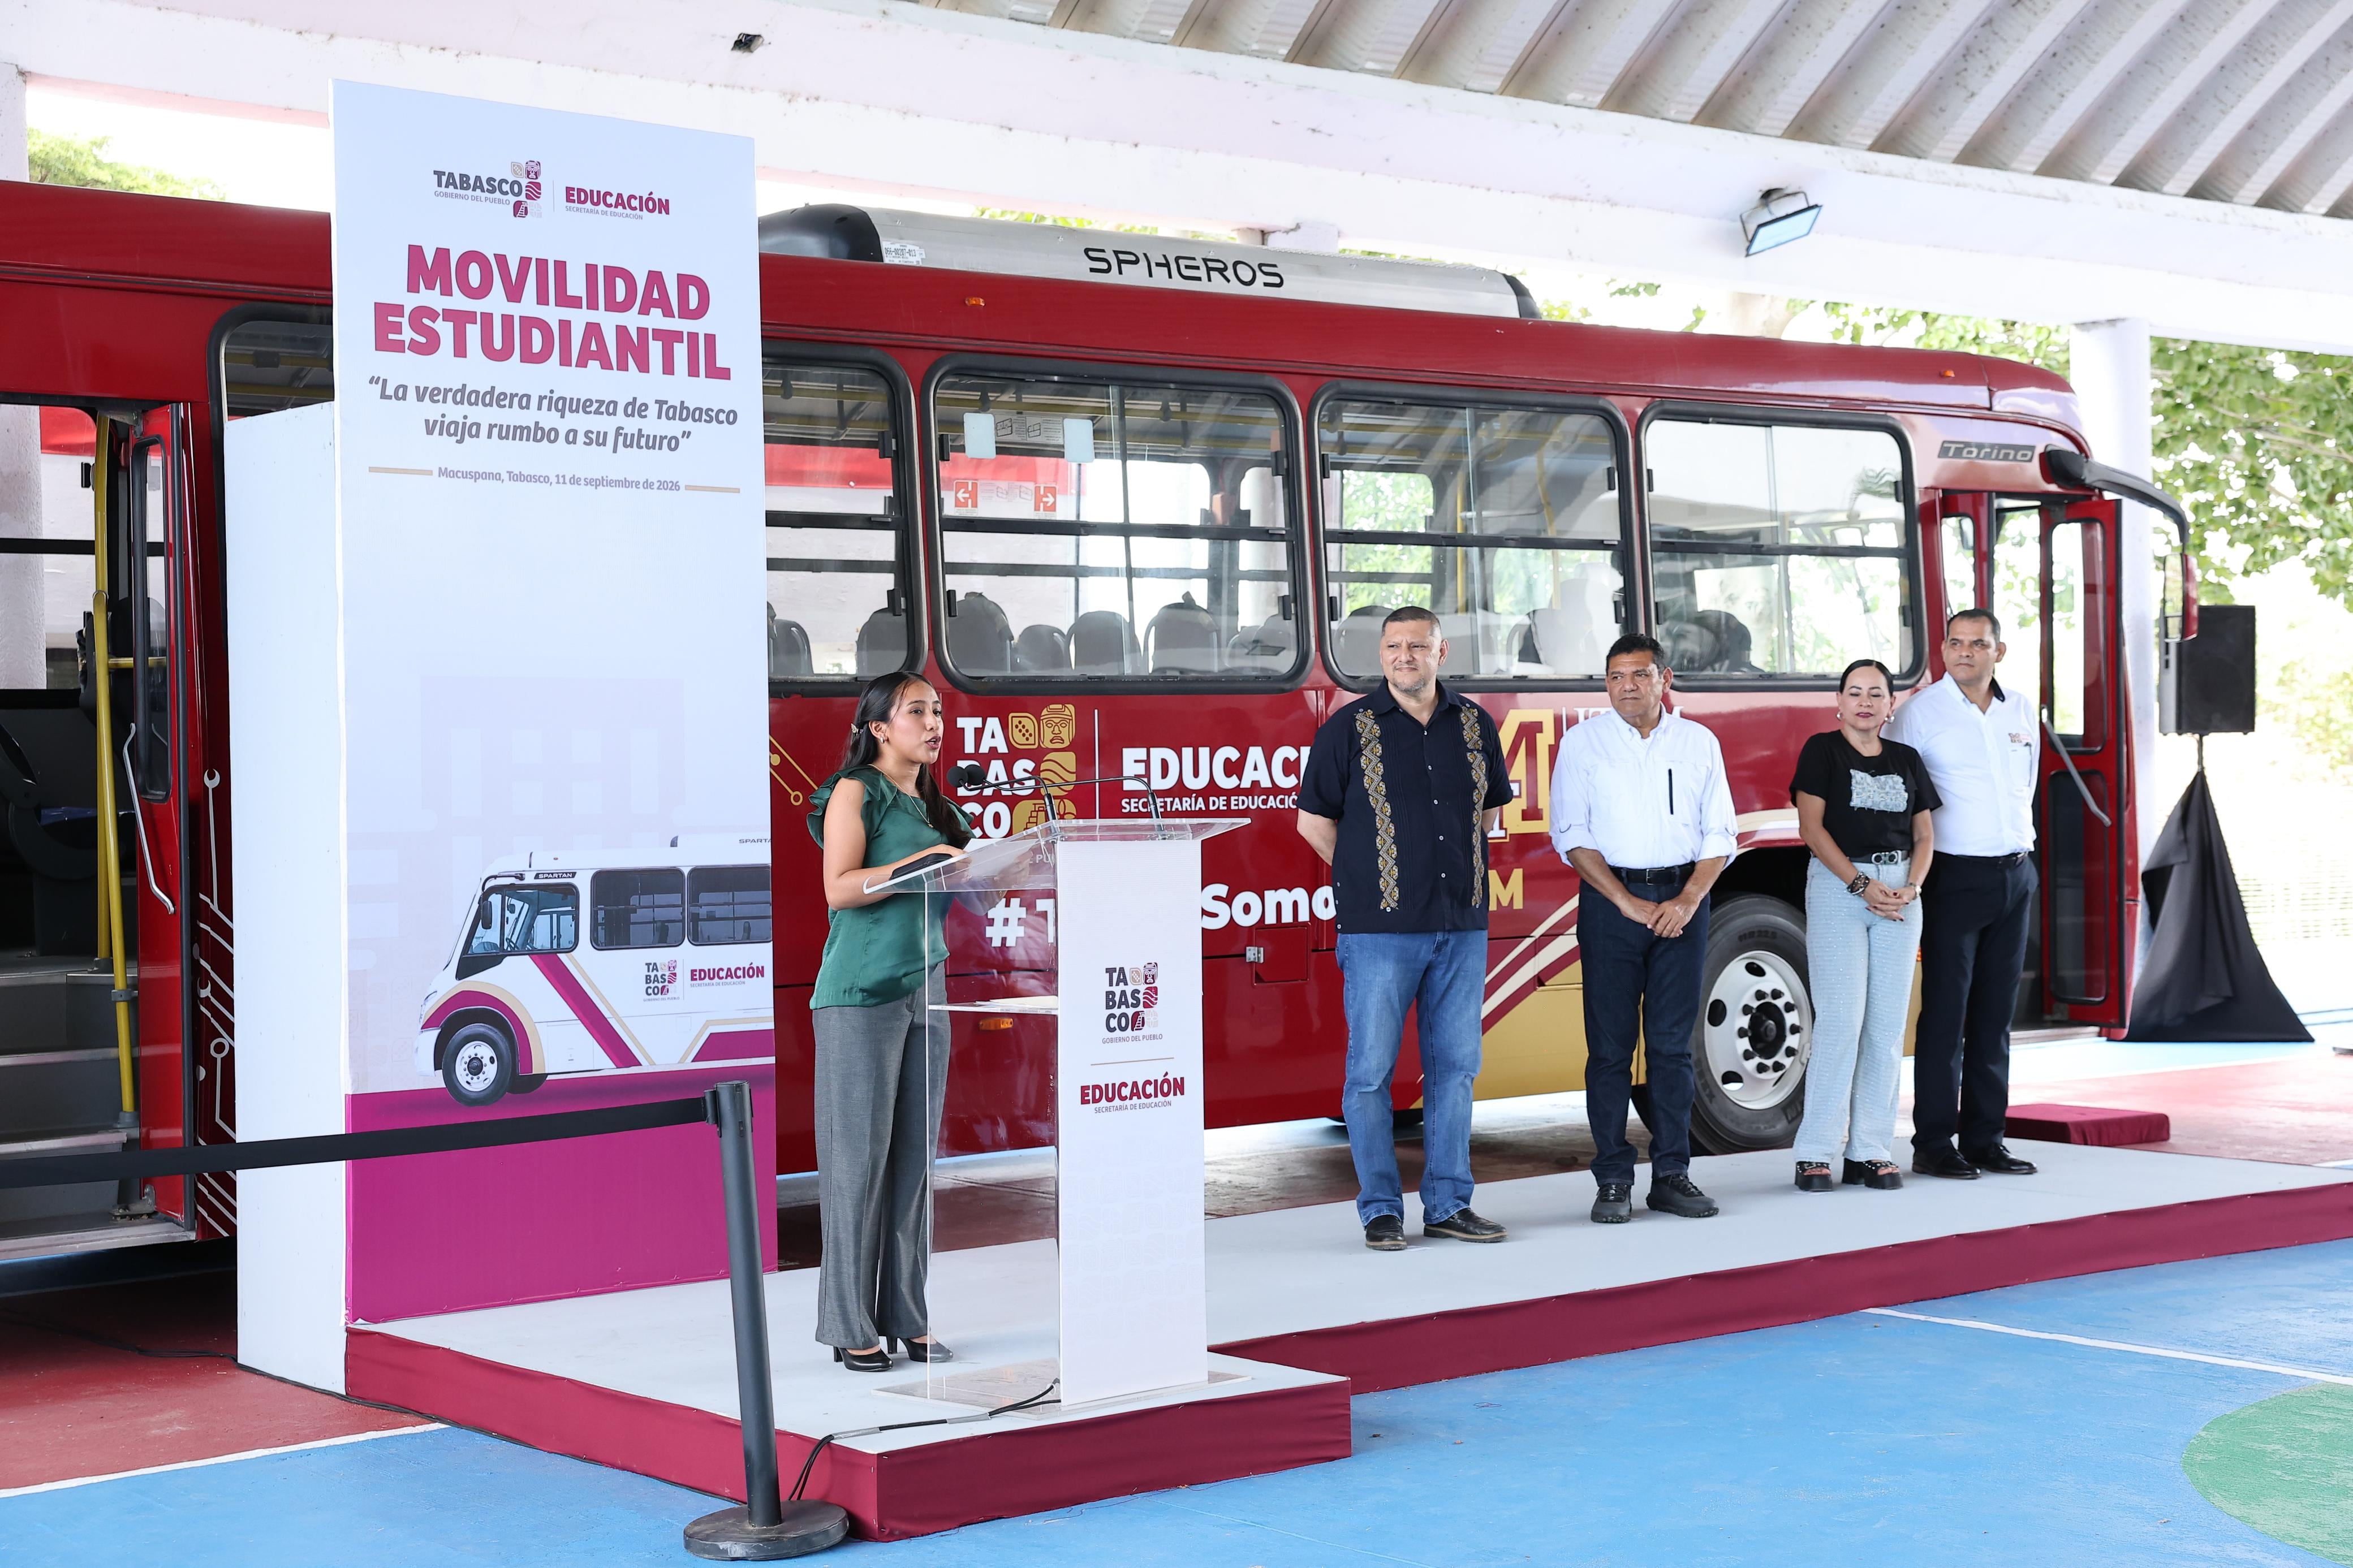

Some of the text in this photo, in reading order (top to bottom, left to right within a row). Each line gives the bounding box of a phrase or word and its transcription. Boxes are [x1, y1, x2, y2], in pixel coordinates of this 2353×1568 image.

[433, 170, 523, 197] TABASCO
[434, 190, 469, 200] GOBIERNO
[485, 196, 510, 205] PUEBLO
[566, 186, 670, 215] EDUCACIÓN
[565, 205, 600, 215] SECRETARÍA
[610, 211, 643, 220] EDUCACIÓN
[1084, 247, 1284, 288] SPHEROS
[407, 244, 710, 321] MOVILIDAD
[374, 302, 731, 381] ESTUDIANTIL
[415, 383, 532, 411] verdadera
[537, 389, 618, 419] riqueza
[623, 397, 649, 419] de
[654, 399, 738, 425] Tabasco
[424, 413, 481, 444] viaja
[486, 421, 559, 444] rumbo
[564, 429, 578, 445] a
[583, 429, 608, 447] su
[1943, 442, 2033, 460] Torino
[438, 466, 680, 491] Macuspana, Tabasco, 11 de septiembre de 2026
[956, 717, 1009, 754] TA
[1121, 793, 1206, 813] SECETARÍA
[1209, 796, 1227, 810] DE
[645, 962, 659, 973] TA
[691, 962, 765, 981] EDUCACIÓN
[1105, 967, 1128, 987] TA
[645, 973, 667, 984] BAS
[645, 986, 660, 996] CO
[1105, 989, 1141, 1010] BAS
[1105, 1012, 1130, 1033] CO
[1102, 1036, 1130, 1044] GOBIERNO
[1080, 1071, 1185, 1105] EDUCACIÓN
[1094, 1103, 1128, 1113] SECRETARÍA
[1139, 1099, 1172, 1109] EDUCACIÓN
